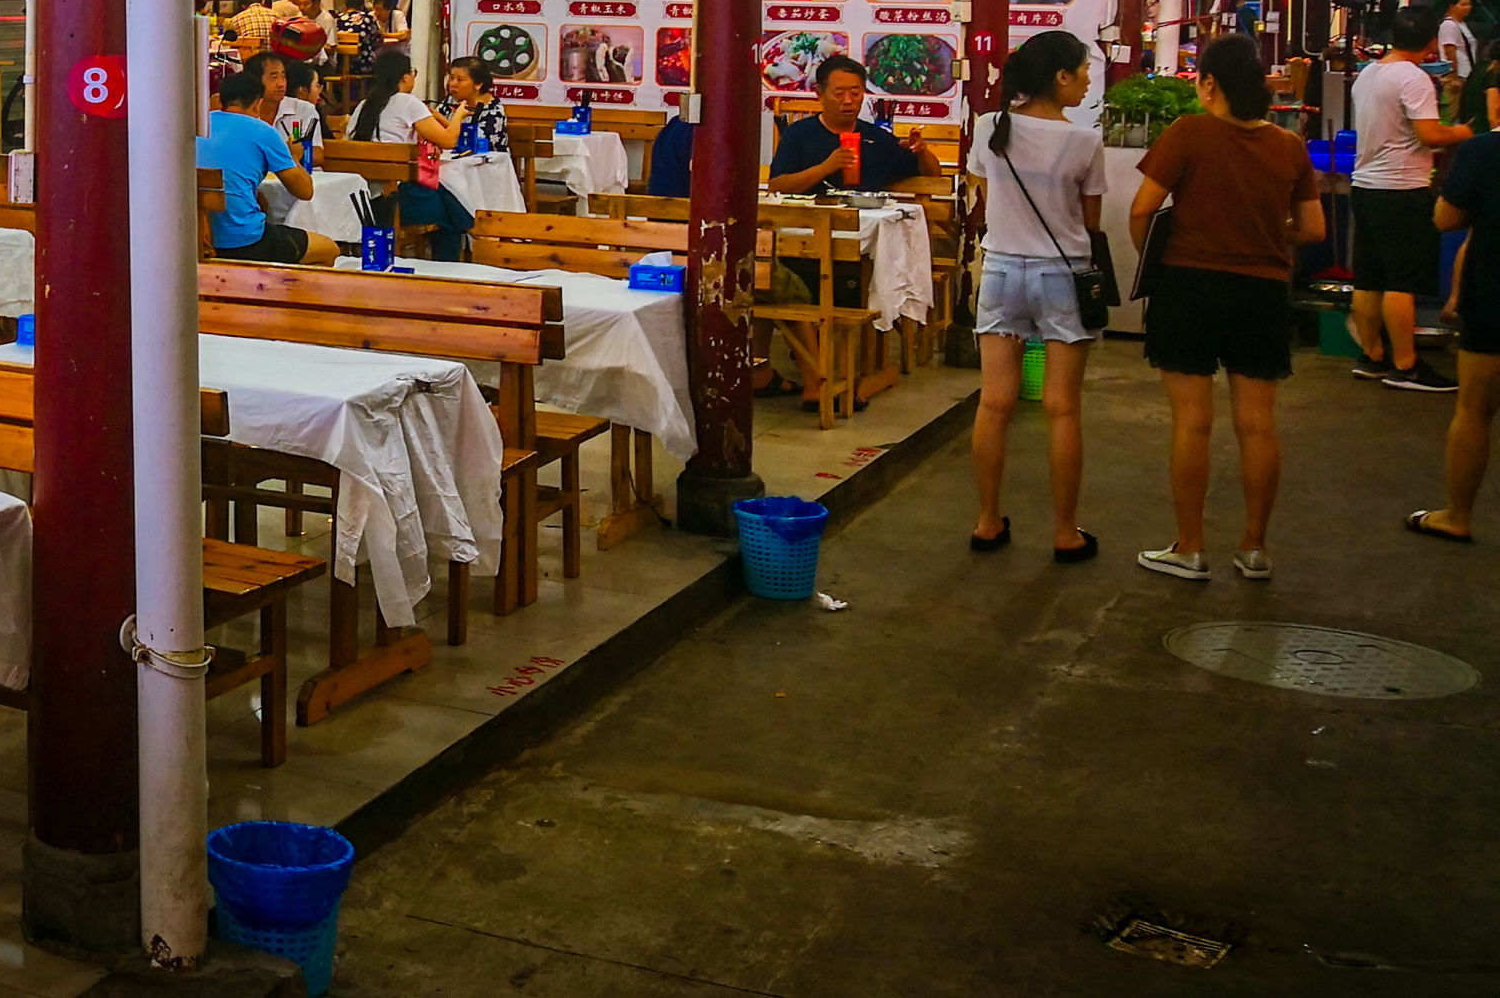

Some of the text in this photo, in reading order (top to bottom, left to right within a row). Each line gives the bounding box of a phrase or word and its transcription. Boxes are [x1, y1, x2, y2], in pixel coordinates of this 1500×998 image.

[492, 3, 526, 14] 口水鸡
[578, 4, 627, 15] 青椒玉米
[776, 8, 831, 21] 番茄炒蛋
[878, 10, 947, 22] 酸菜粉丝汤
[1009, 13, 1058, 25] 肉片汤
[974, 35, 992, 51] 11
[83, 67, 109, 104] 8
